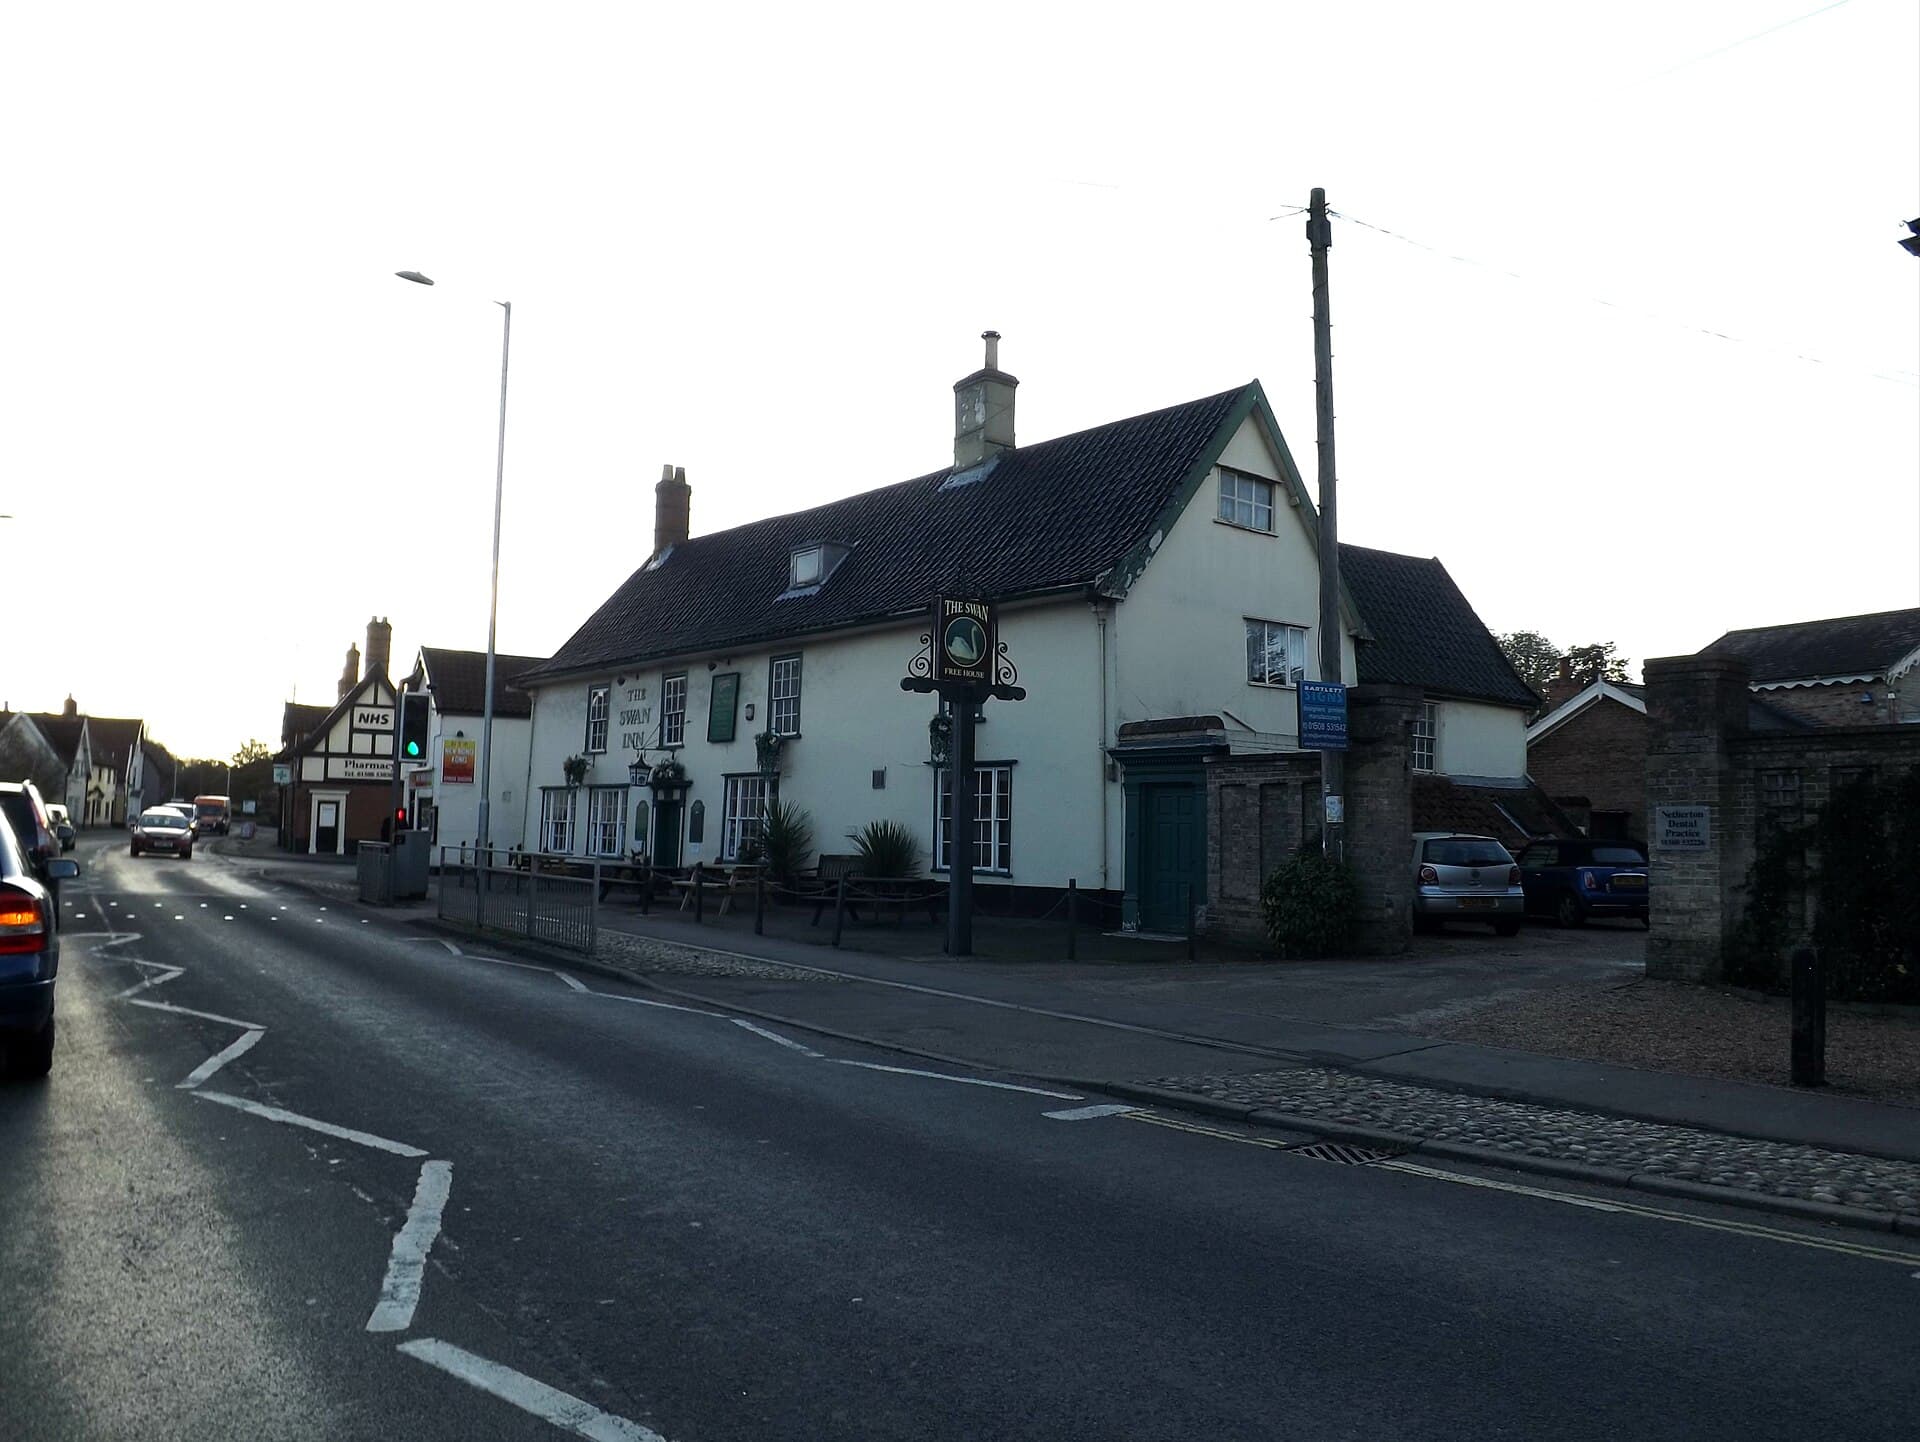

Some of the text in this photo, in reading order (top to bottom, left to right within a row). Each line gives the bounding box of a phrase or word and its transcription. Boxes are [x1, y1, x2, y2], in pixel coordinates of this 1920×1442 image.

[945, 600, 989, 623] THE SWAN
[944, 667, 985, 679] FREE HOUSE
[627, 688, 646, 702] THE
[1304, 685, 1343, 693] BARTLETT
[1304, 692, 1344, 703] SIGNS
[358, 712, 390, 725] NHS
[619, 707, 651, 726] SWAN
[622, 731, 645, 749] INN
[1662, 810, 1704, 818] Netherton
[1668, 820, 1697, 828] Dental
[1666, 829, 1700, 838] Practice
